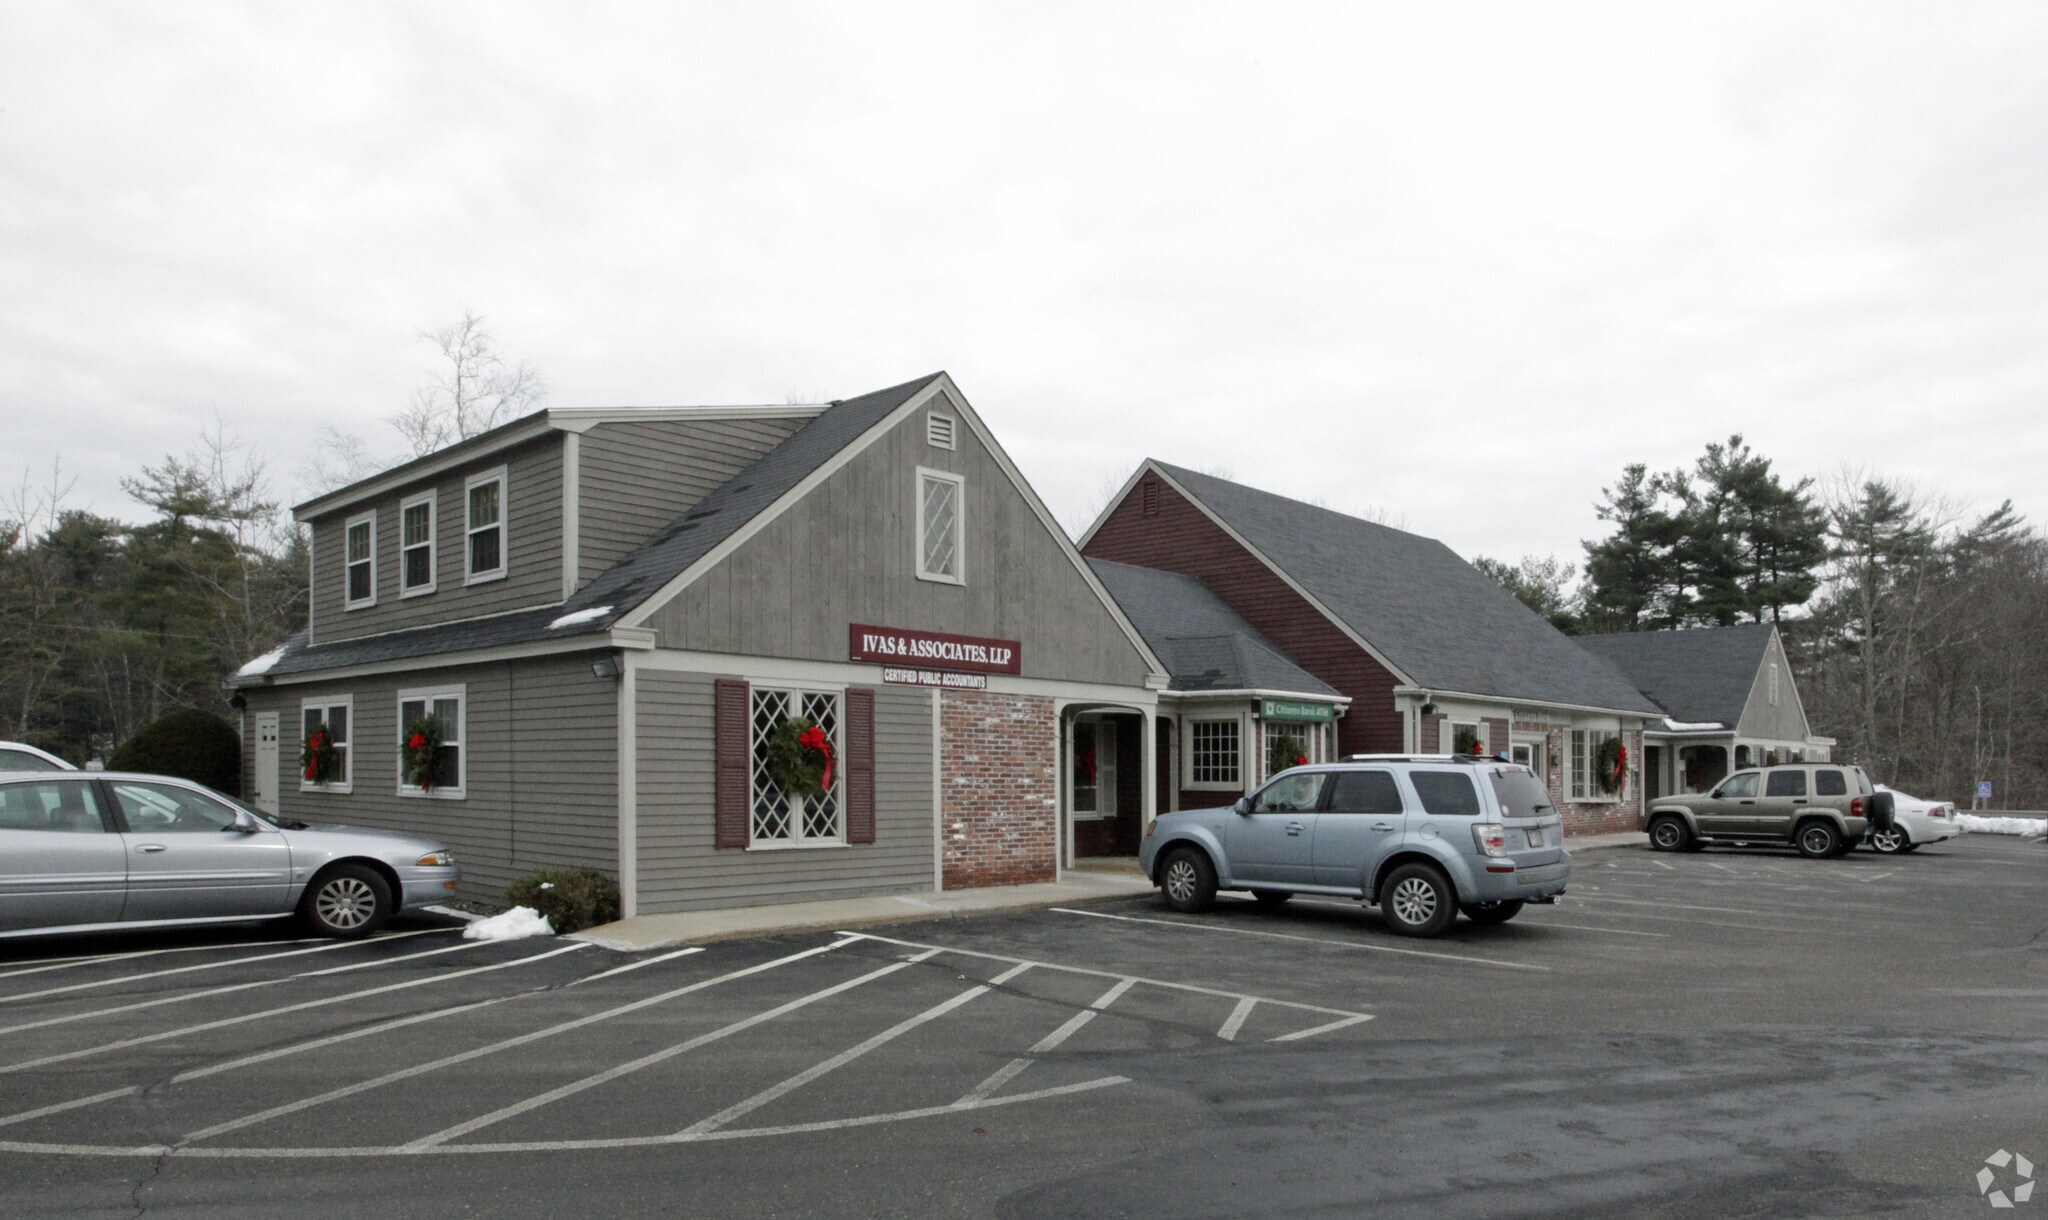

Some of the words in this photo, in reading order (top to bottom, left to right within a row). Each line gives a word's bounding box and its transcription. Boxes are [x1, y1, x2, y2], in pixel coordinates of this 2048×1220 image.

[863, 634, 895, 655] IVAS
[898, 638, 907, 655] &
[909, 639, 988, 664] ASSOCIATES,
[990, 646, 1011, 665] LLP
[884, 668, 917, 683] CERTIFIED
[918, 670, 941, 686] PUBLIC
[942, 673, 985, 688] ACCOUNTANTS
[1276, 704, 1300, 715] Citizens
[1301, 705, 1315, 716] Bank
[1316, 707, 1328, 718] ATM
